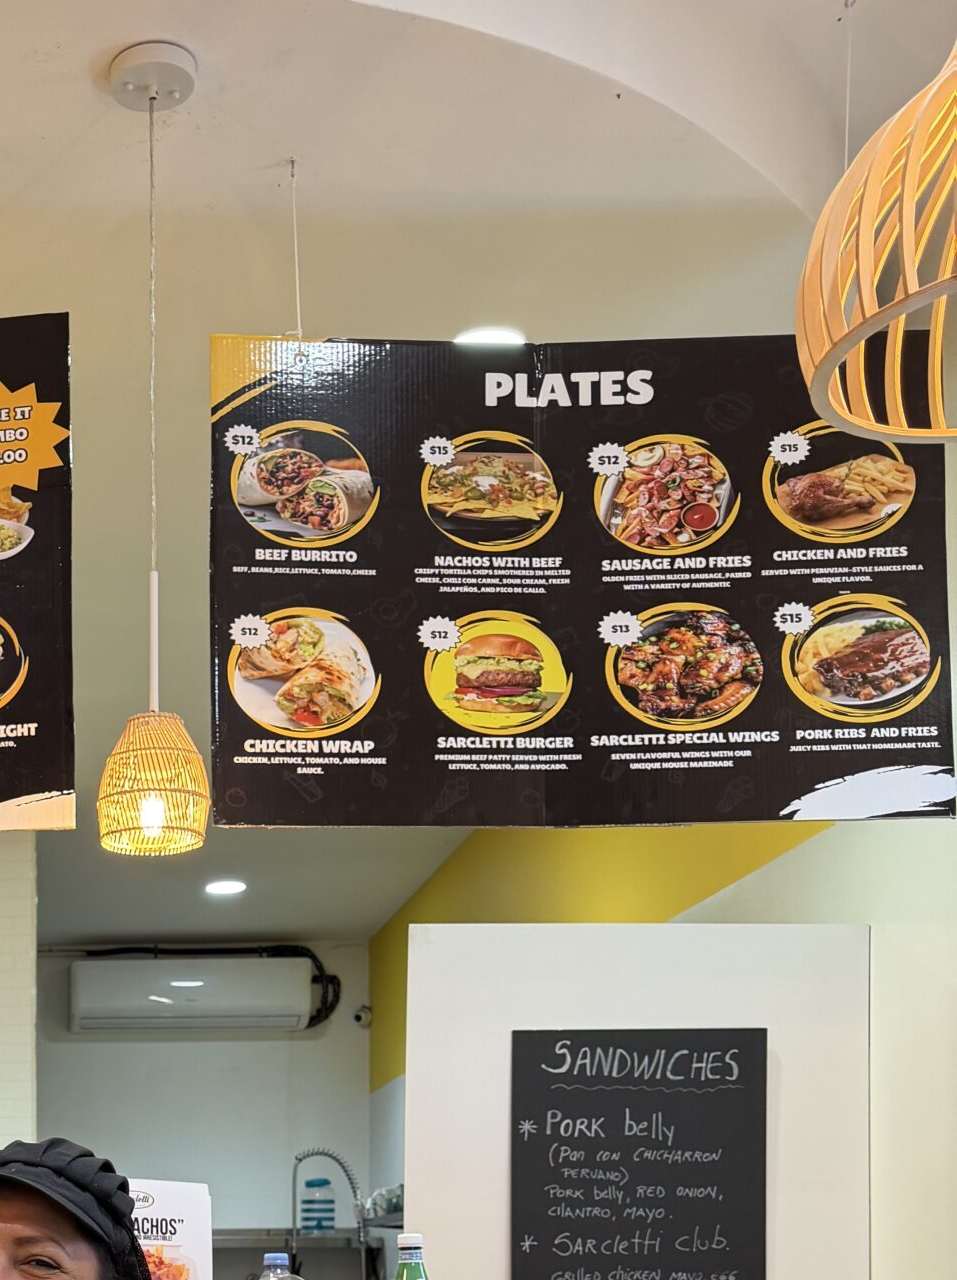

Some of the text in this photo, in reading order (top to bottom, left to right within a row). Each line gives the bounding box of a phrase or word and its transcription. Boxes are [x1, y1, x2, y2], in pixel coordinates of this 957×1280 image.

[485, 370, 654, 407] PLATES
[14, 406, 33, 420] IT
[231, 435, 254, 446] $12
[429, 445, 448, 455] $15
[780, 443, 799, 453] $15
[597, 455, 619, 465] $12
[255, 548, 358, 562] BEEF BURRITO
[772, 546, 908, 561] CHICKEN AND FRIES
[434, 556, 563, 568] NACHOS WITH BEEF
[601, 555, 752, 571] SAUSAGE AND FRIES
[812, 575, 873, 584] UNIQUE FLAVOR.
[779, 613, 802, 624] $15
[241, 627, 258, 636] $12
[430, 630, 449, 639] $12
[611, 624, 630, 633] $13
[590, 731, 780, 746] SARCLETTI SPECIAL WINGS
[796, 726, 938, 740] PORK RIBS AND FRIES
[244, 739, 375, 753] CHICKEN WRAP
[437, 737, 573, 749] SARCLETTI BURGER
[234, 756, 270, 764] CHICKEN,
[305, 757, 342, 765] TOMATO,
[630, 760, 733, 770] UNIQUE HOUSE MARINADE
[541, 1040, 739, 1081] SANDWICHES
[624, 1107, 675, 1147] belly
[633, 1147, 722, 1164] CHICHARRON
[562, 1166, 629, 1186] PERUANO)
[636, 1186, 665, 1198] RED
[676, 1186, 723, 1201] ONION,
